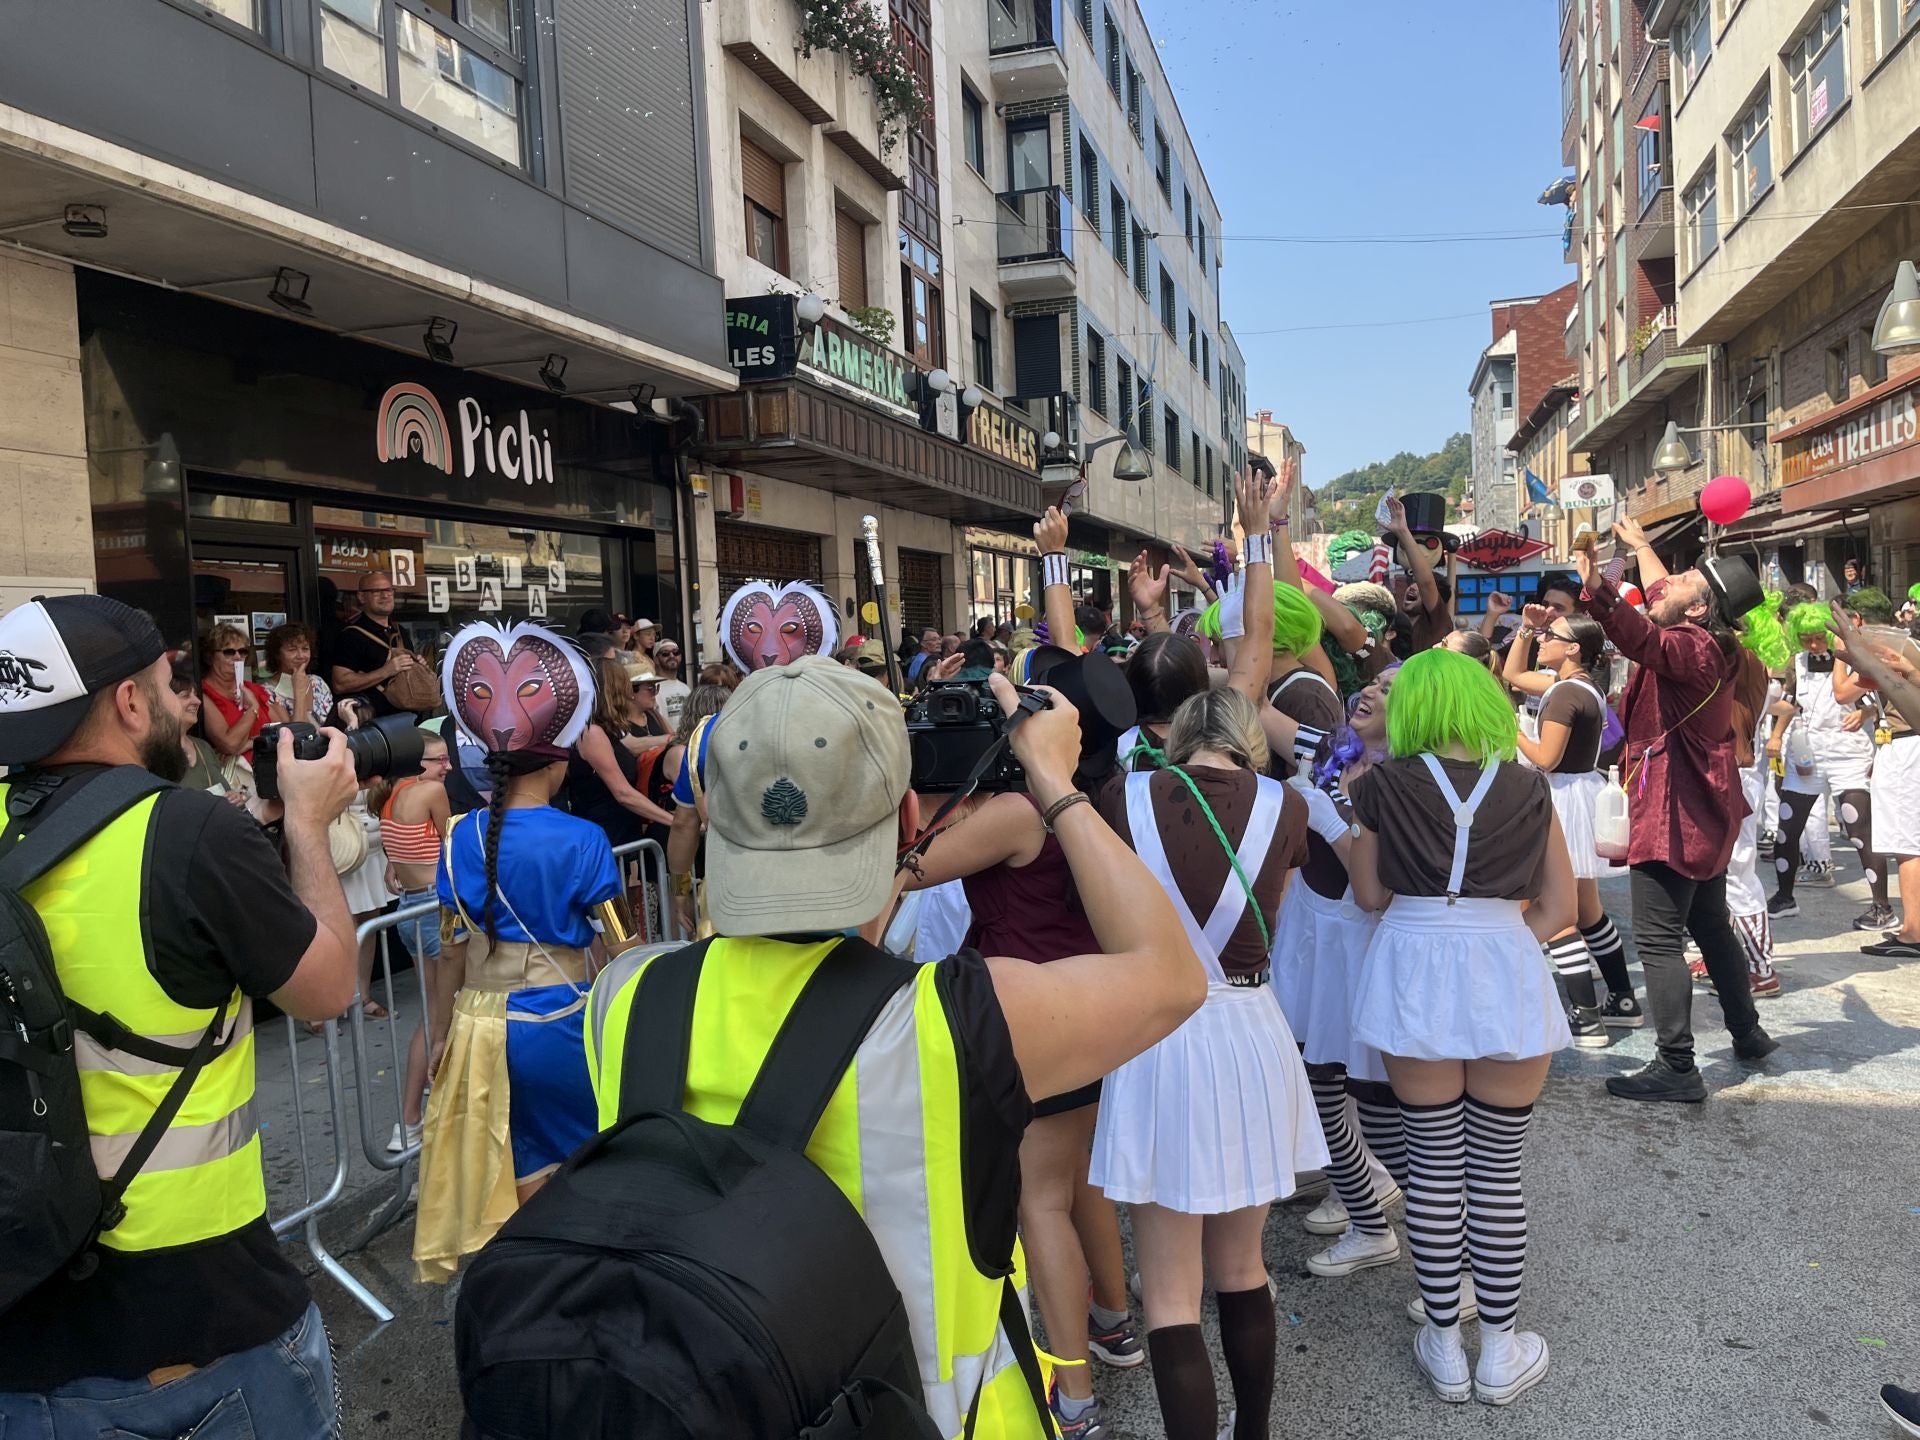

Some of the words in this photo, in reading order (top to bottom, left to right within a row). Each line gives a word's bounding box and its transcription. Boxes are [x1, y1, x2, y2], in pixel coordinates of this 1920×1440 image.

[728, 345, 776, 367] LES
[458, 396, 554, 485] Pichi
[1811, 431, 1834, 460] CASA
[1836, 390, 1917, 464] TRELLES
[1564, 497, 1612, 509] BUNKAI
